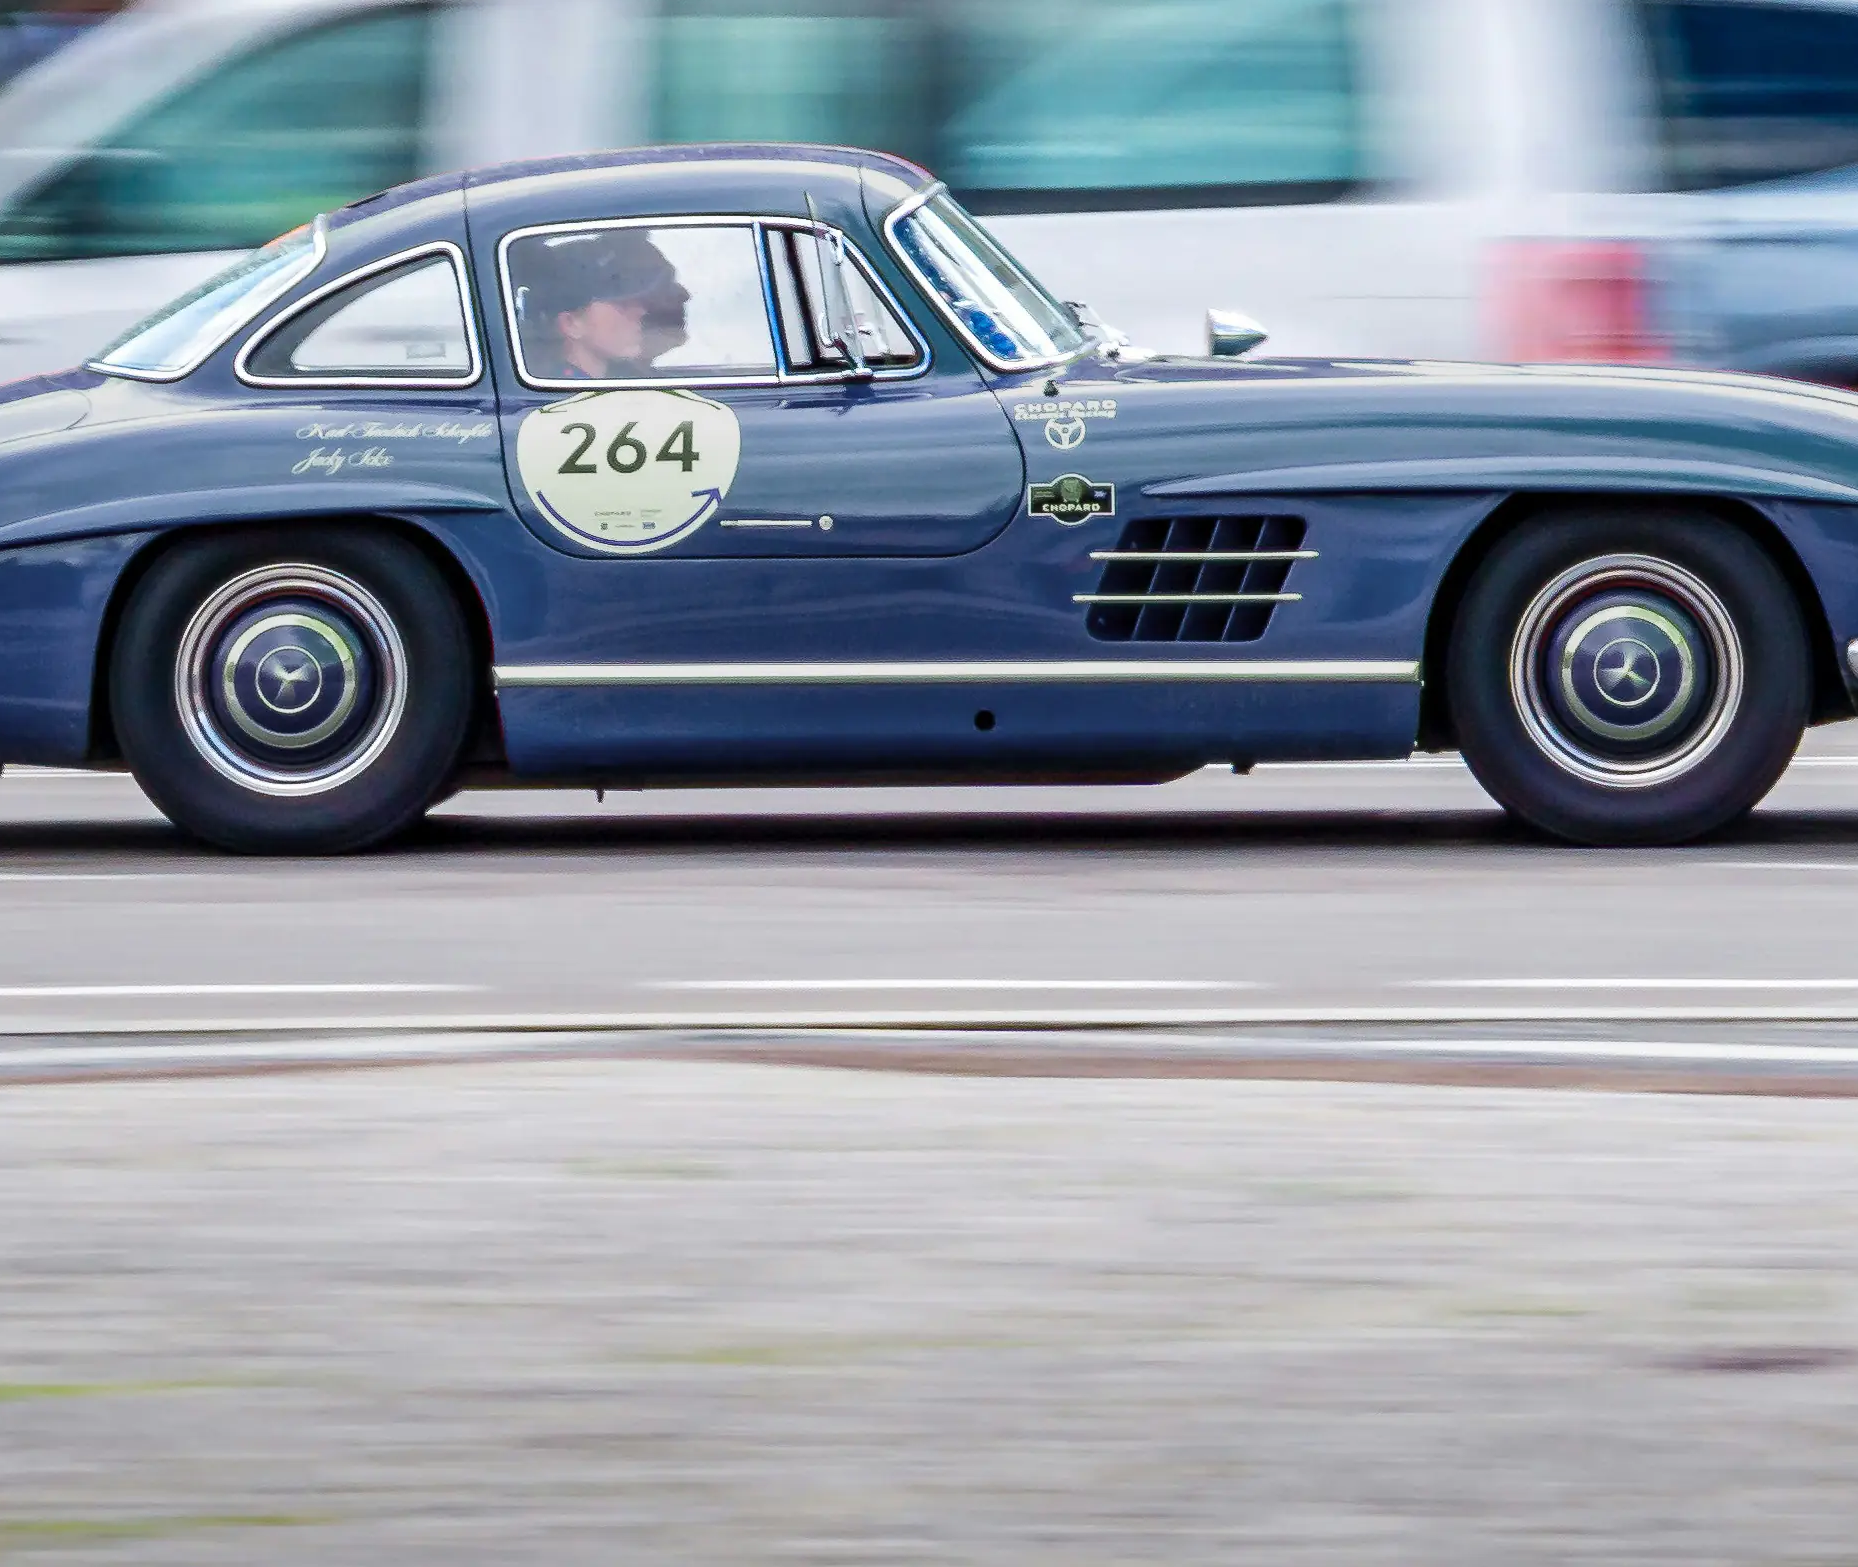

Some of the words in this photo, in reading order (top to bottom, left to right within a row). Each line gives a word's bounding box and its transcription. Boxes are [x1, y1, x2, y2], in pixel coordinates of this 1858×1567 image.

[1014, 400, 1117, 412] CHOPARD
[558, 420, 700, 474] 264
[1042, 503, 1101, 512] CHOPARD
